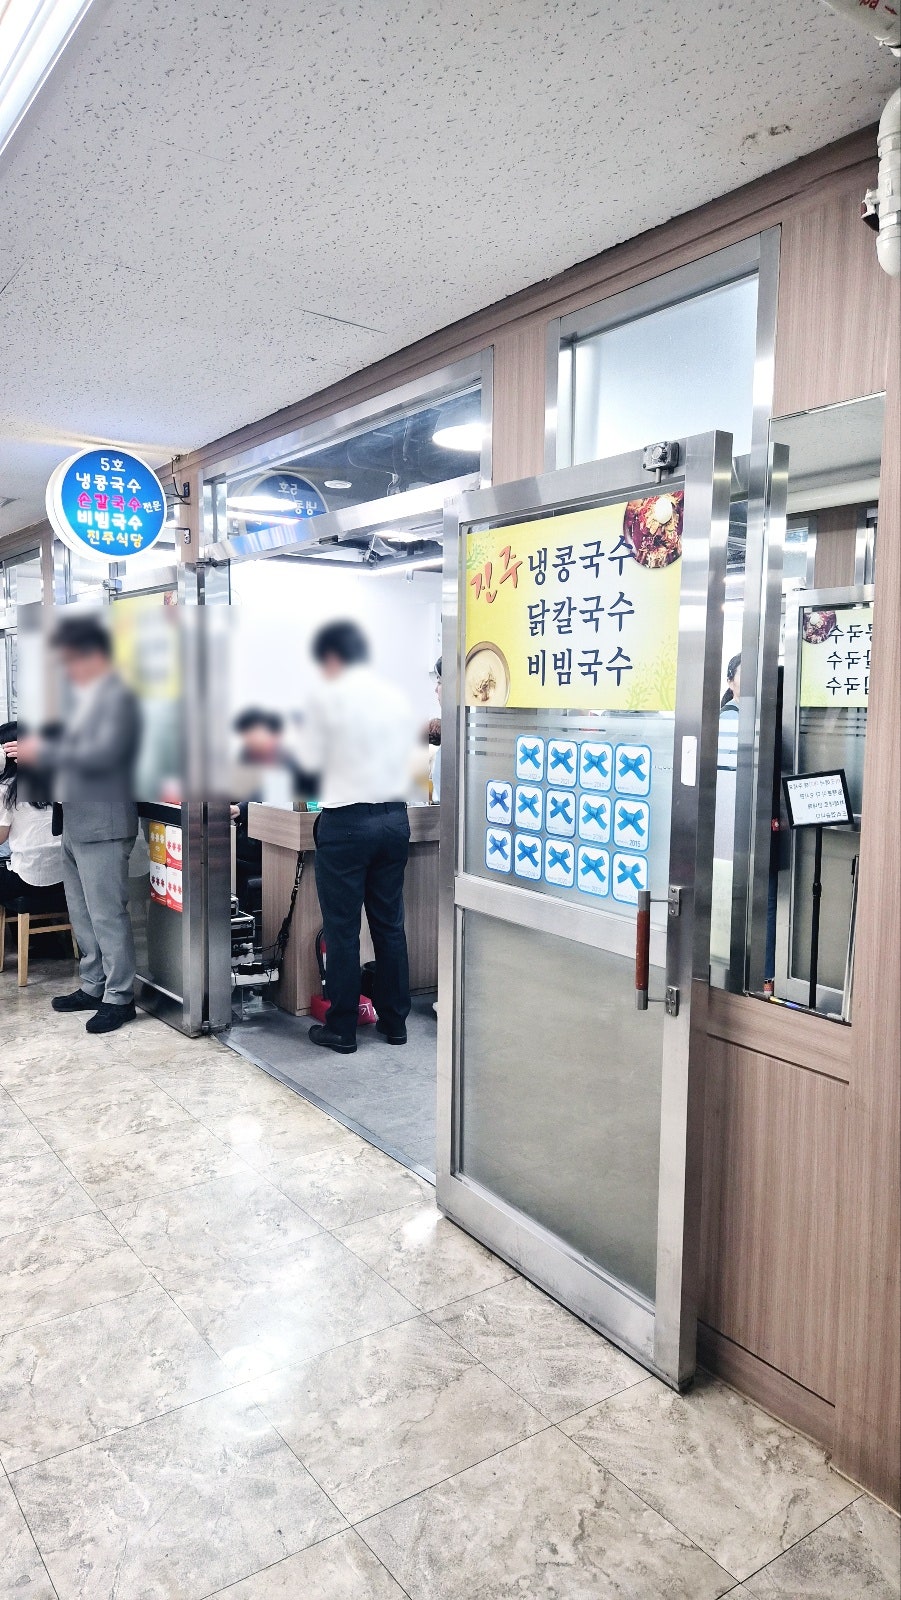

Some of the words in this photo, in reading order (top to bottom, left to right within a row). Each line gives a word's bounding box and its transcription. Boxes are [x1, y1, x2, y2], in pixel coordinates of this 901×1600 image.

[100, 457, 126, 472] 5호
[76, 472, 142, 494] 냉콩국수
[77, 491, 142, 512] 손칼국수
[77, 510, 143, 531] 비빔국수
[87, 529, 143, 548] 진주식당
[470, 545, 523, 604] 진주
[527, 535, 636, 586] 냉콩국수
[527, 591, 635, 638] 닭칼국수
[527, 646, 634, 687] 비빔국수
[629, 839, 641, 848] 2015
